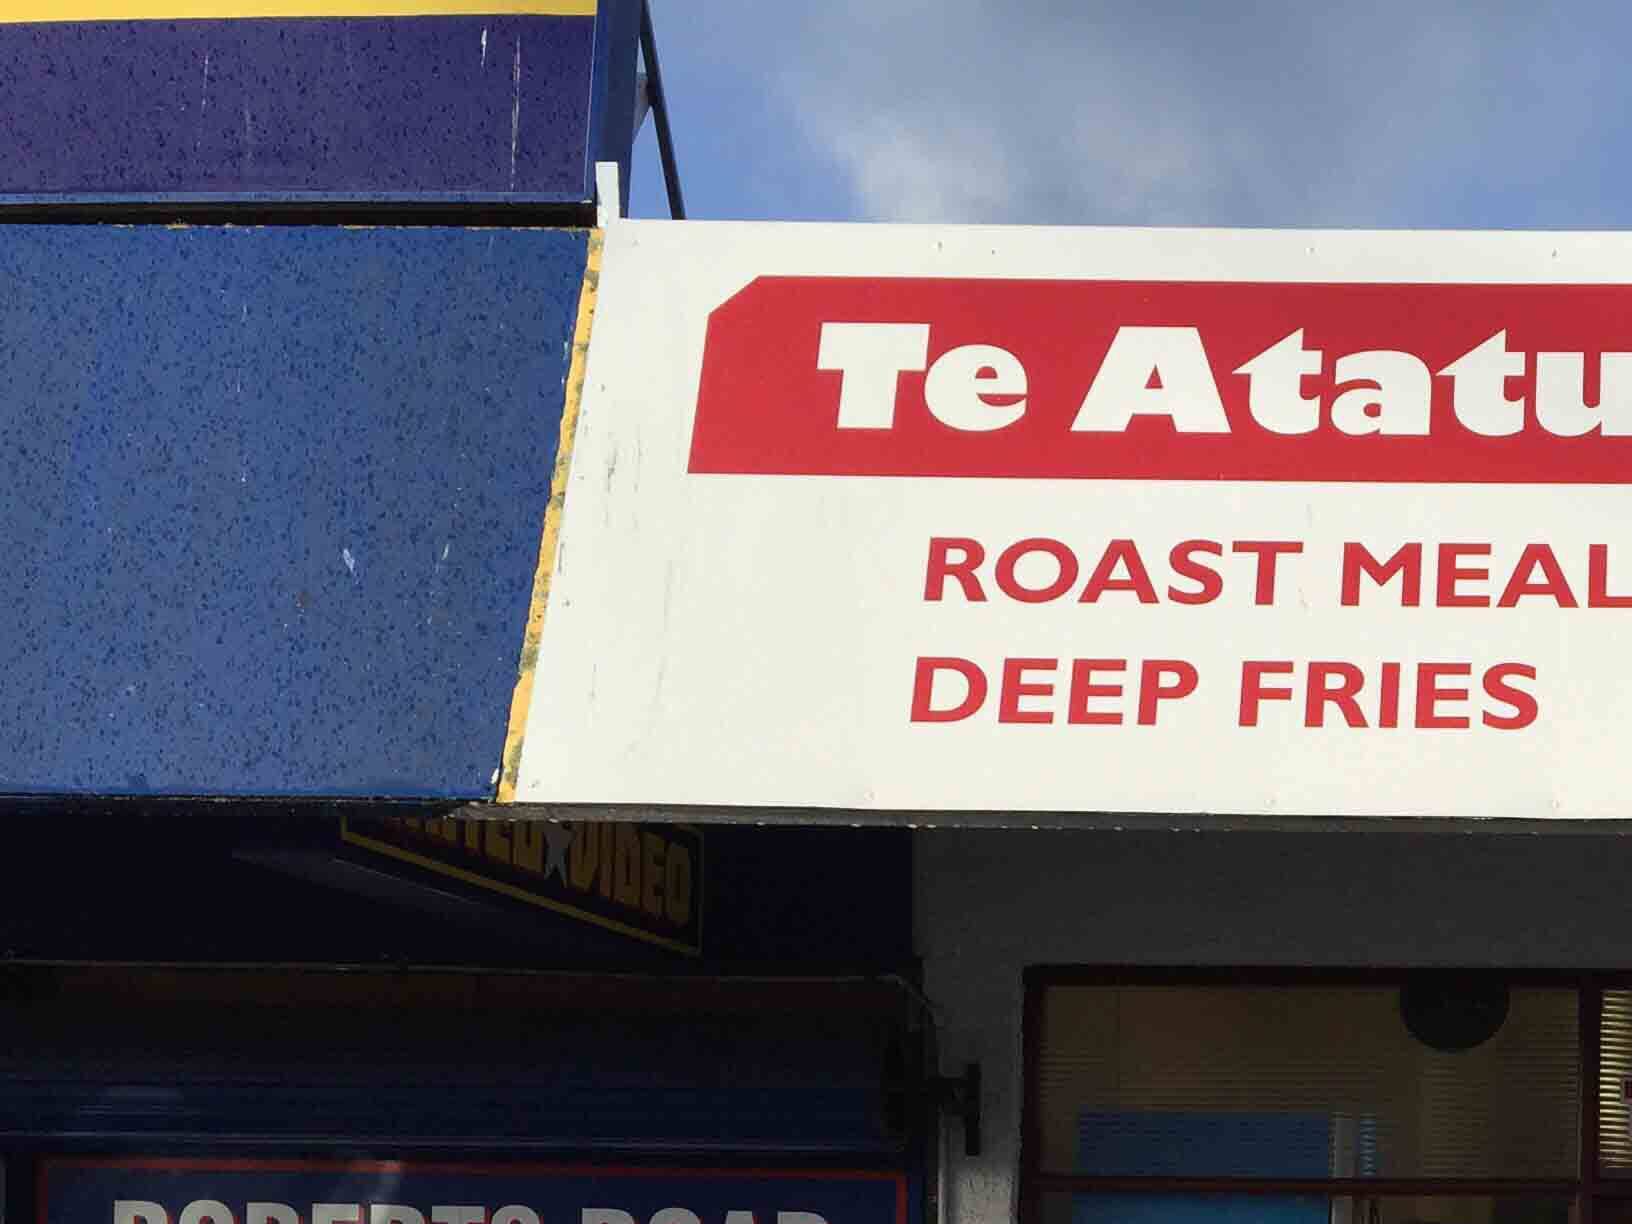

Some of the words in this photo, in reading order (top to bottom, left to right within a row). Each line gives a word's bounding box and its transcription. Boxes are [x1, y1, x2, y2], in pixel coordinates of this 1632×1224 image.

[816, 321, 1028, 432] Te
[922, 536, 1304, 606] ROAST
[909, 656, 1200, 727] DEEP
[1238, 659, 1540, 730] FRIES
